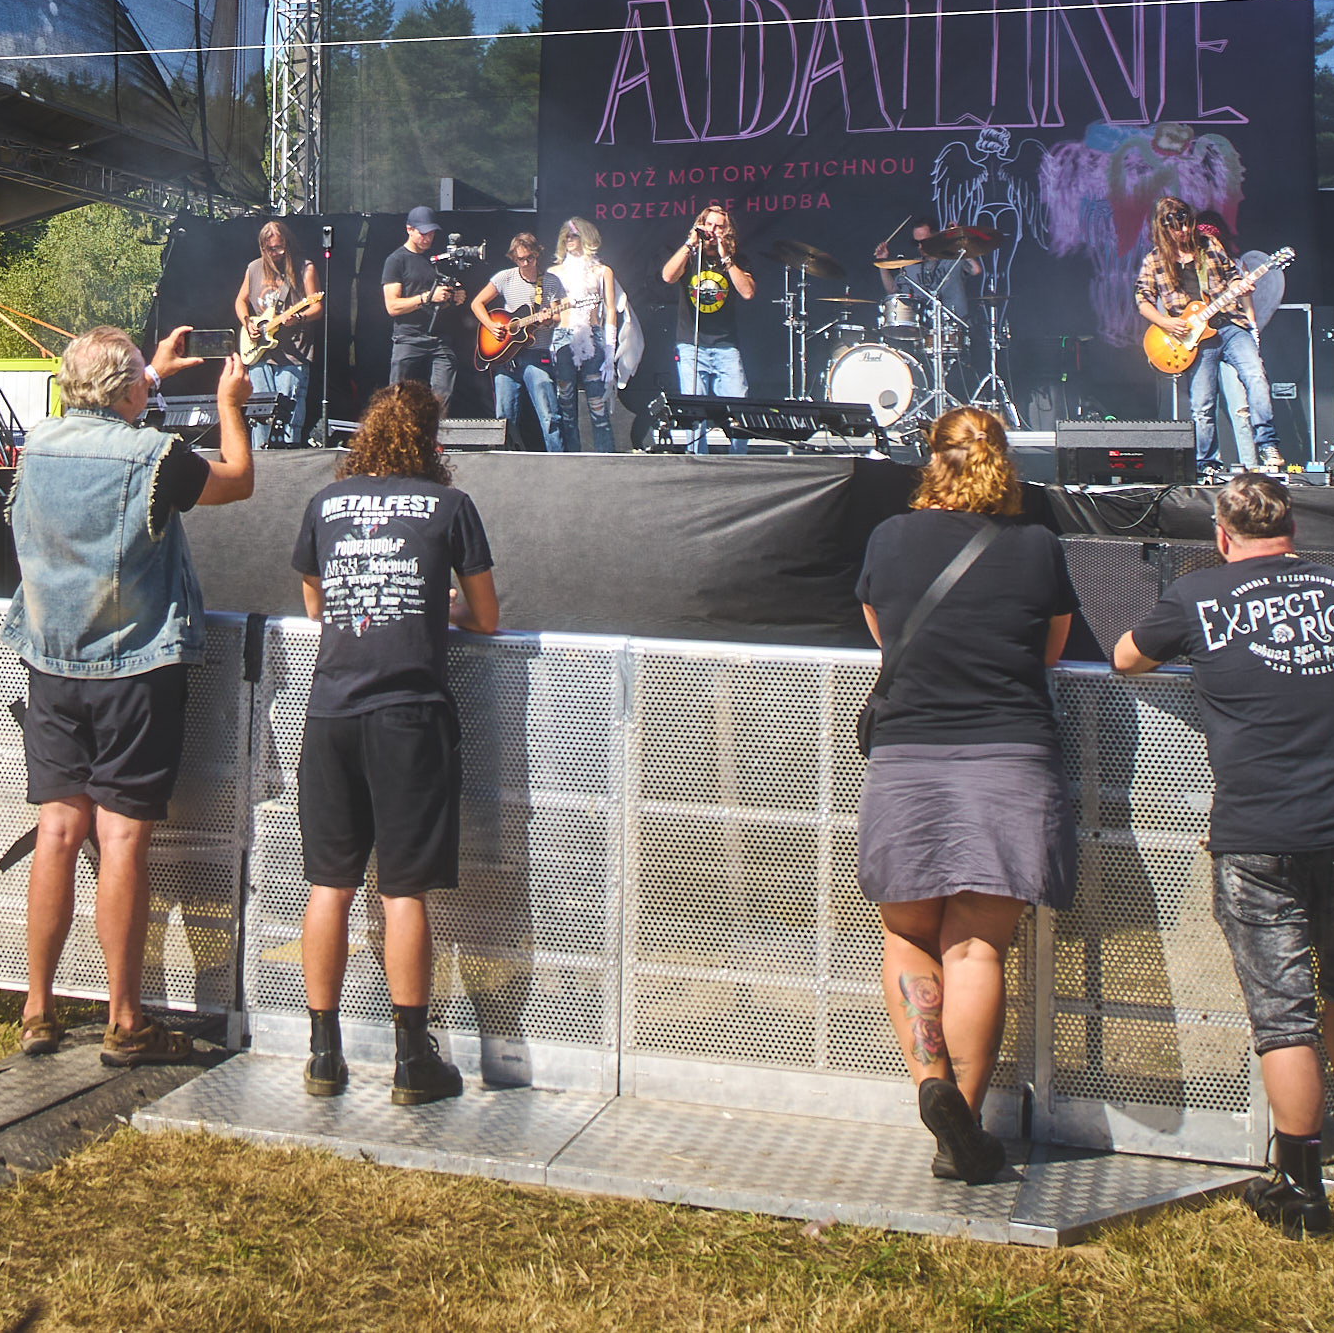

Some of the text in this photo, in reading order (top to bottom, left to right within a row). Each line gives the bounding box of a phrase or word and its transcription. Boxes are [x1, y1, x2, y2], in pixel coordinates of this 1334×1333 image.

[594, 157, 915, 188] KDYŽ MOTORY ZTICHNOU
[595, 195, 697, 219] ROZEZNÍ
[746, 192, 832, 213] HUDBA
[322, 494, 440, 518] METALFEST
[334, 537, 406, 557] POWERWOLF
[1196, 589, 1325, 652] EXPECT
